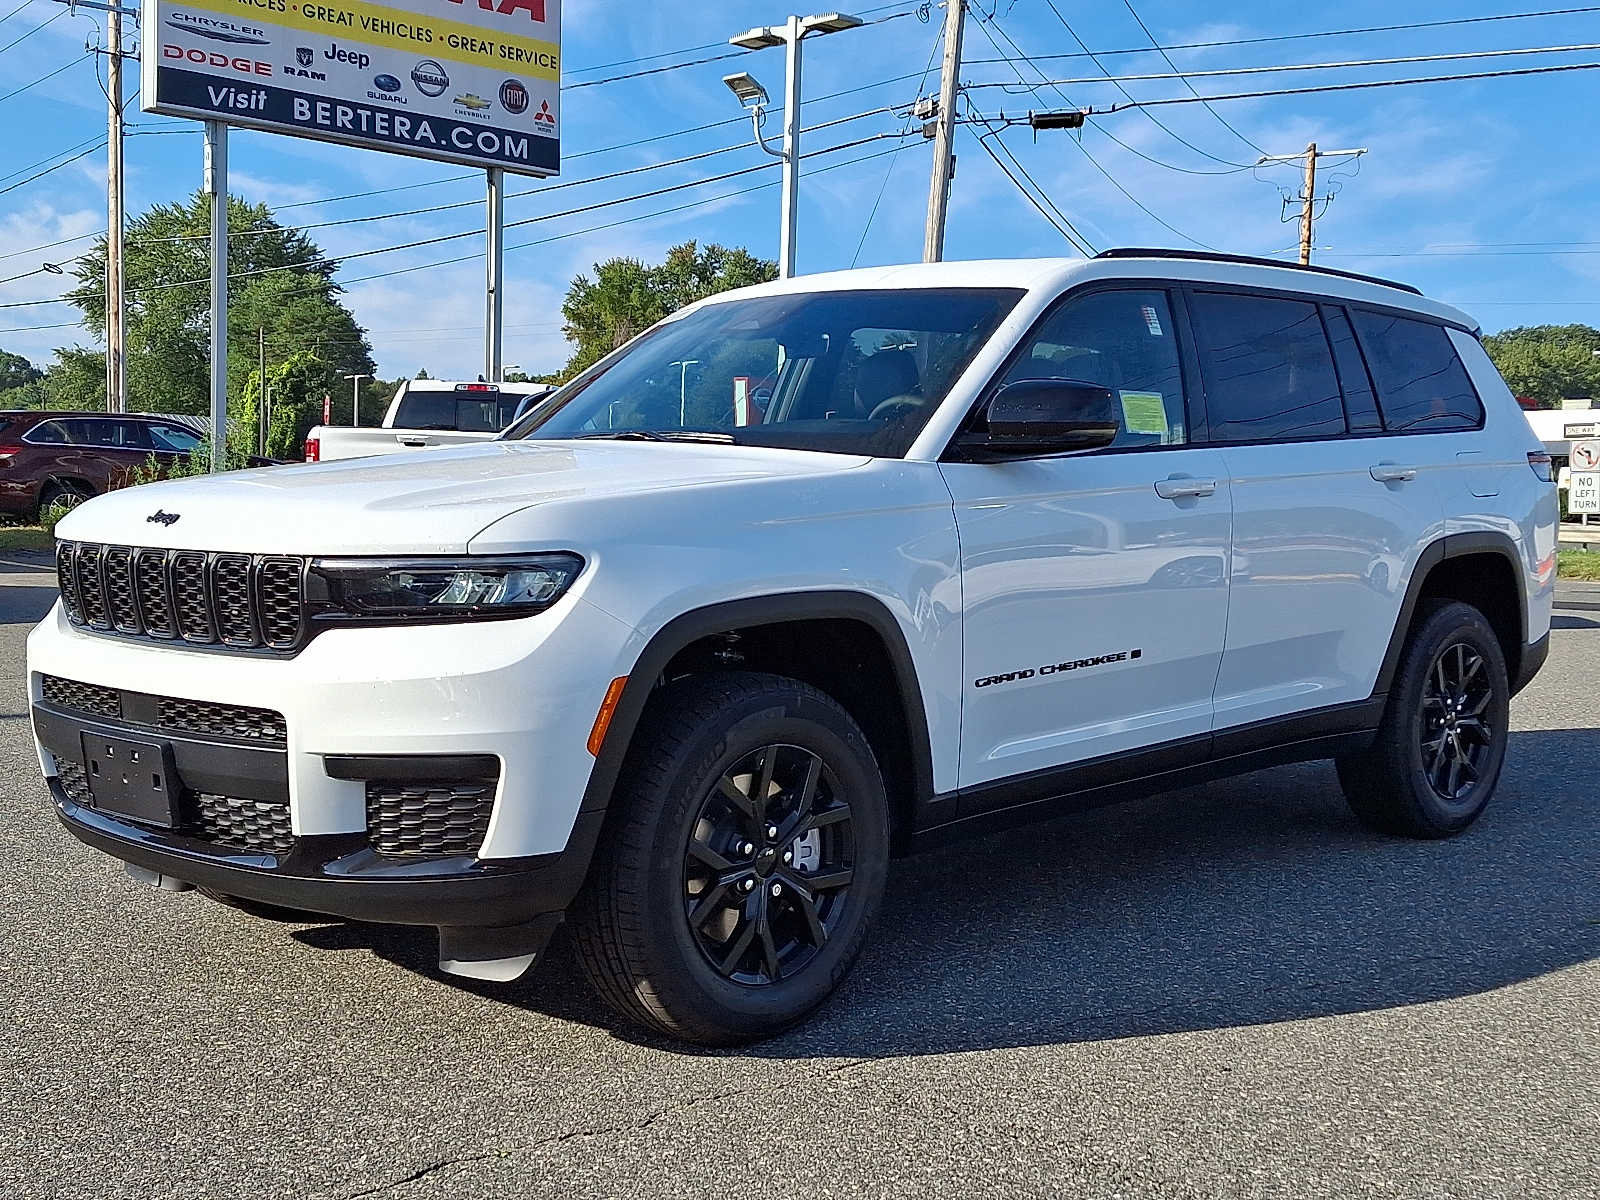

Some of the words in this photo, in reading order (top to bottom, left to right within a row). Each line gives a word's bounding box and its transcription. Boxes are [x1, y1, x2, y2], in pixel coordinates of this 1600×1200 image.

[171, 12, 264, 37] CHRYSLER
[303, 4, 354, 26] GREAT
[360, 15, 433, 43] VEHICLES
[447, 34, 494, 56] GREAT
[500, 44, 557, 69] SERVICE
[163, 44, 273, 77] DODGE
[324, 43, 370, 69] Jeep
[283, 65, 327, 81] RAM
[414, 72, 446, 85] NISSAN
[367, 90, 408, 104] SUBARU
[506, 88, 524, 106] FIAT
[207, 85, 268, 111] Visit
[293, 97, 528, 160] BERTERA.COM
[454, 108, 491, 120] CHEVROLET
[1578, 477, 1593, 487] NO
[1575, 489, 1597, 498] LEFT
[1574, 500, 1597, 509] TURN
[974, 668, 1035, 688] GRAND
[1039, 651, 1127, 676] CHEROKEE
